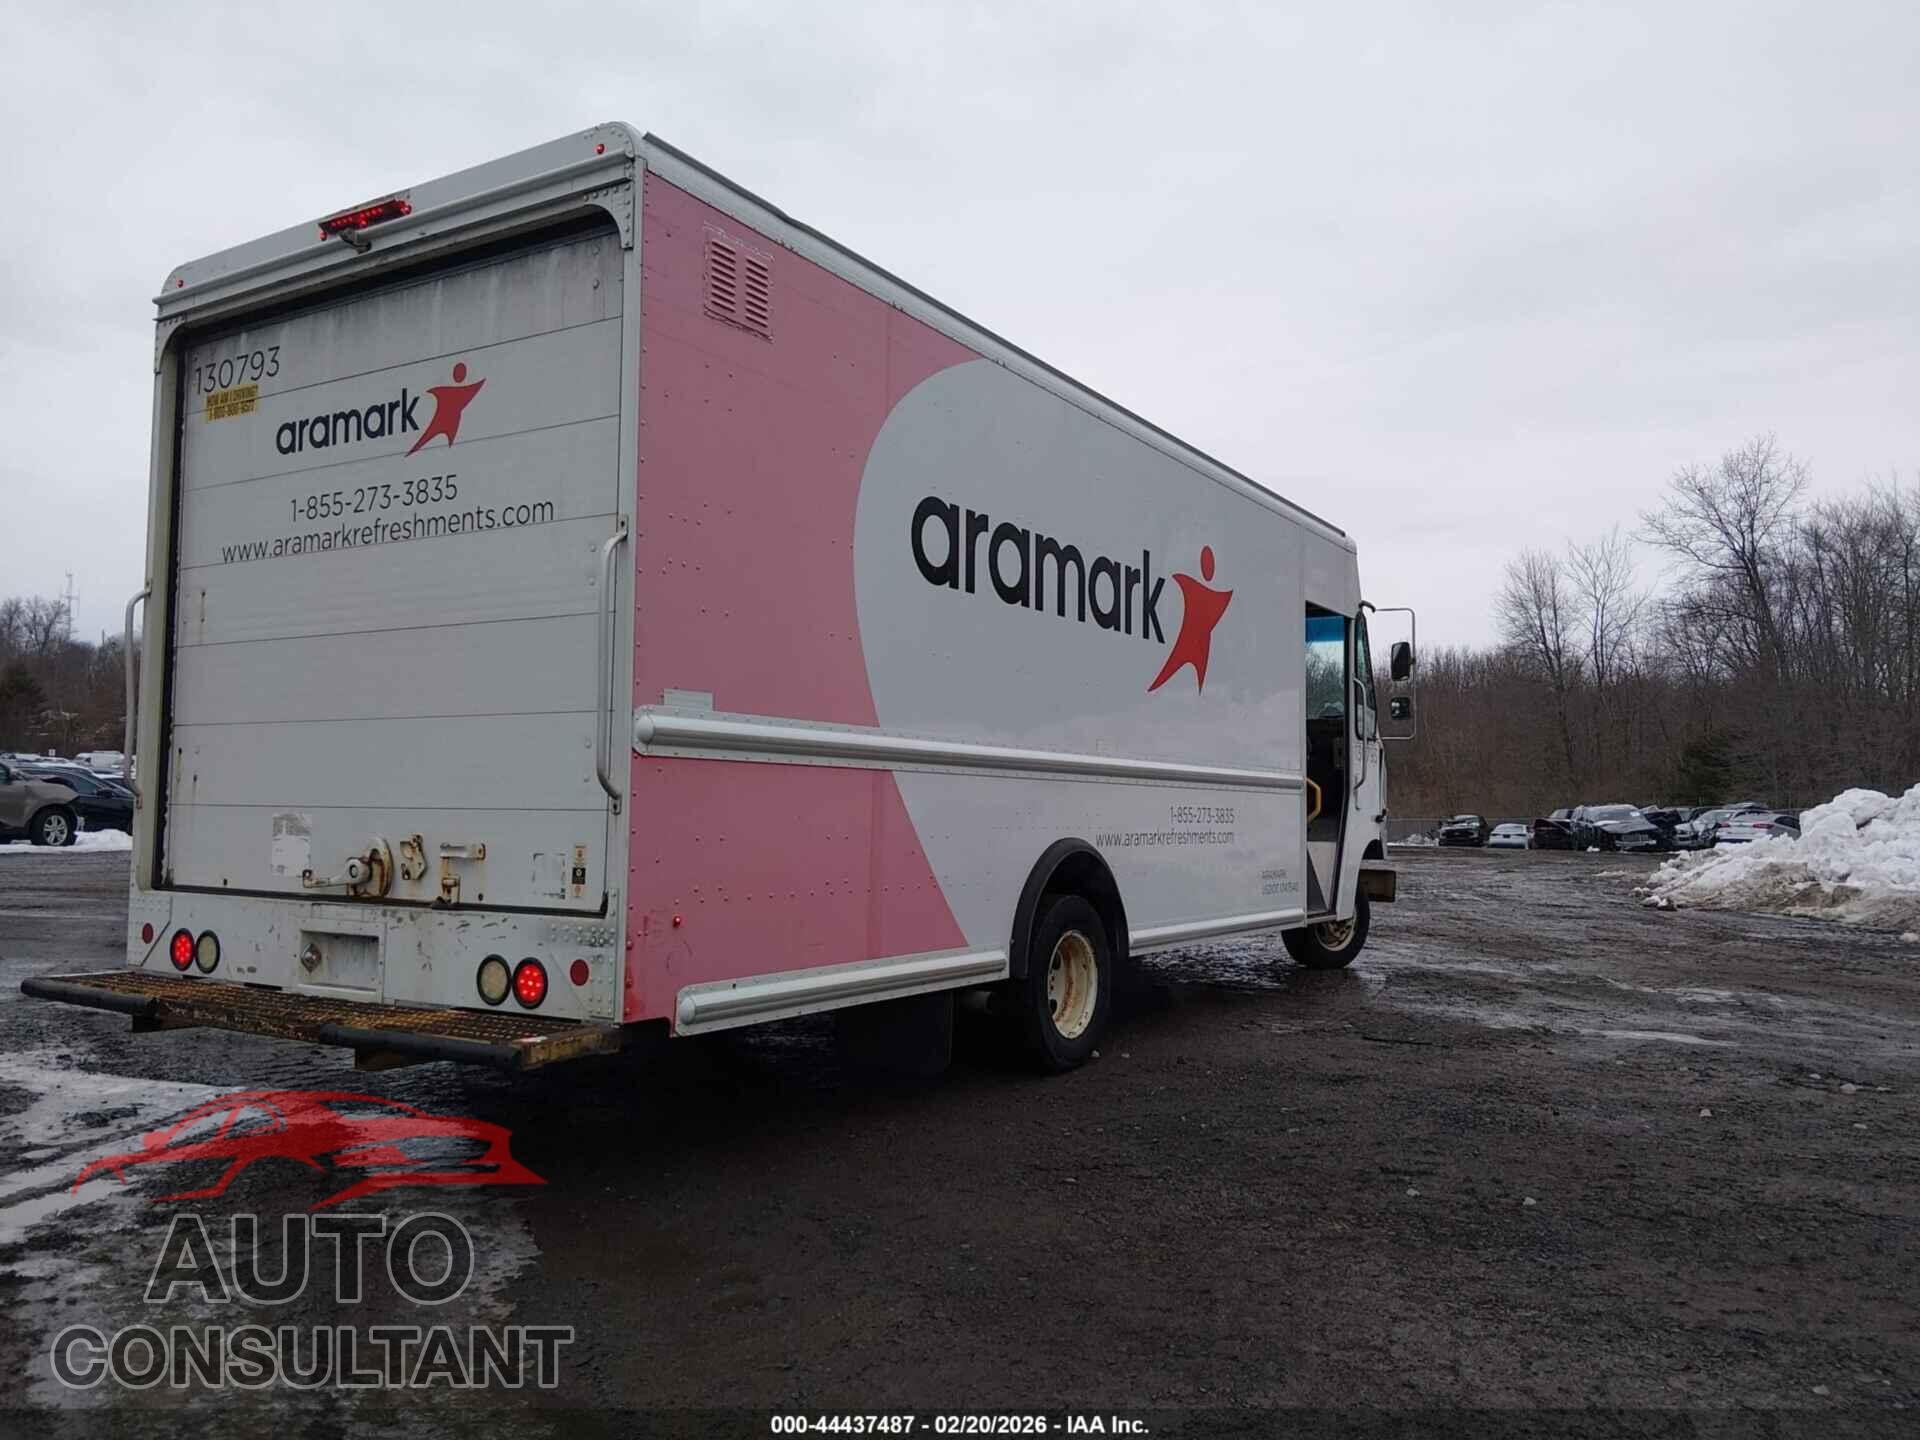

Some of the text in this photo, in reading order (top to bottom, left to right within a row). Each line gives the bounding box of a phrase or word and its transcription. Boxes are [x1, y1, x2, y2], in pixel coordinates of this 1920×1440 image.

[195, 345, 281, 395] 130793
[275, 387, 420, 455] aramark
[289, 474, 458, 522] 1-855-273-3835
[221, 498, 554, 564] www.aramarkrefreshments.com
[911, 495, 1165, 644] aramark
[1095, 828, 1235, 848] www.aramarkrefreshments.com
[1169, 806, 1235, 825] 1-855-273-3835
